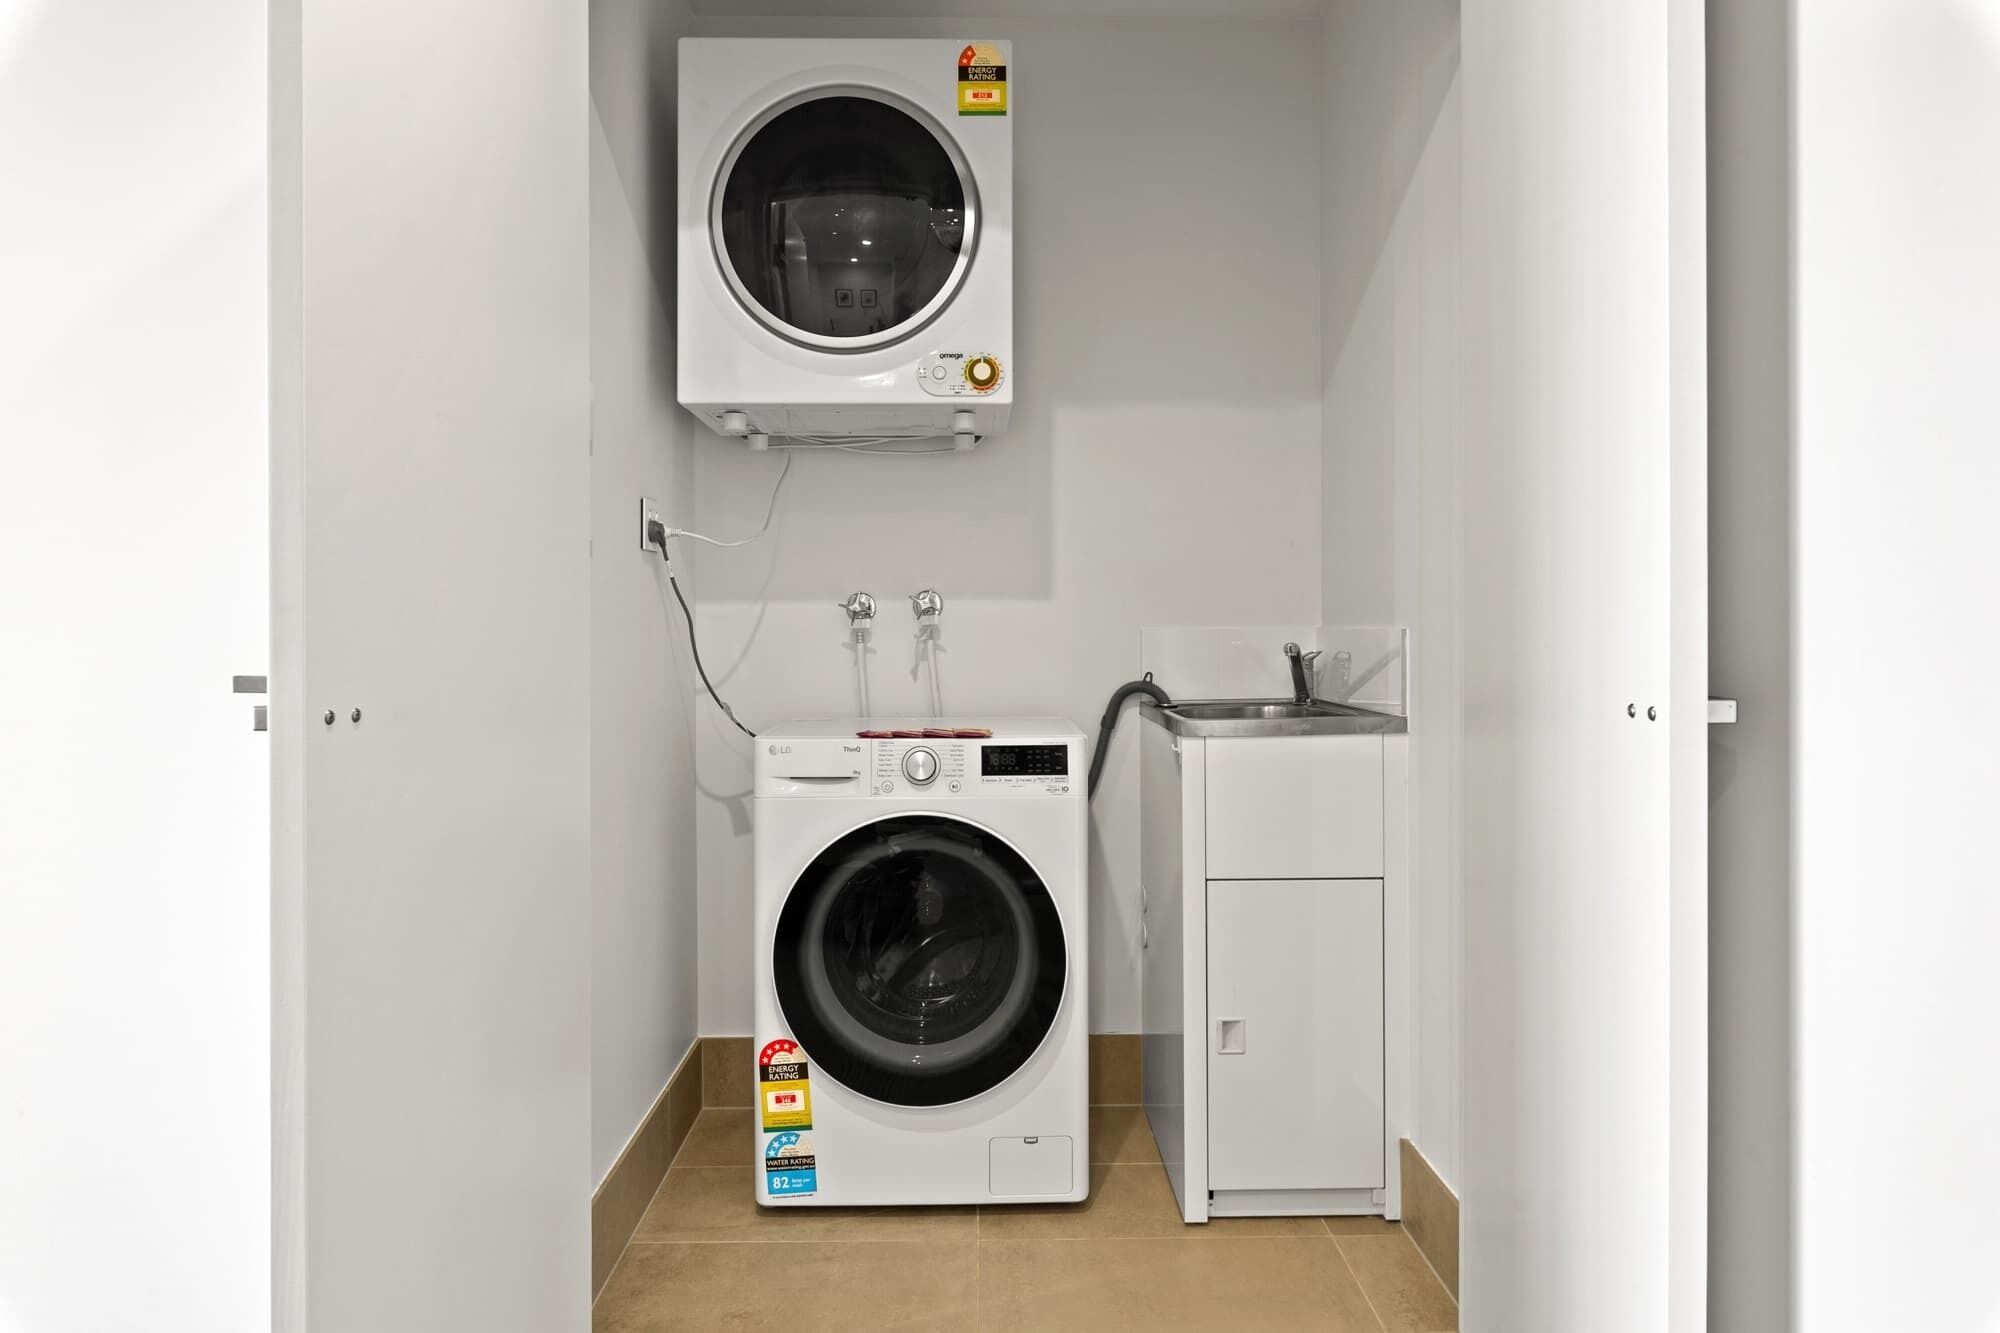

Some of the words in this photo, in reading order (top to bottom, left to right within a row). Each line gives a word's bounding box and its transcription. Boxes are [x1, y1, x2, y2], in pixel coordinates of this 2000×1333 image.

[768, 1065, 799, 1074] ENERGY
[769, 1072, 799, 1081] RATING
[766, 1159, 789, 1167] WATER
[790, 1157, 815, 1166] RATING
[773, 1177, 790, 1189] 82
